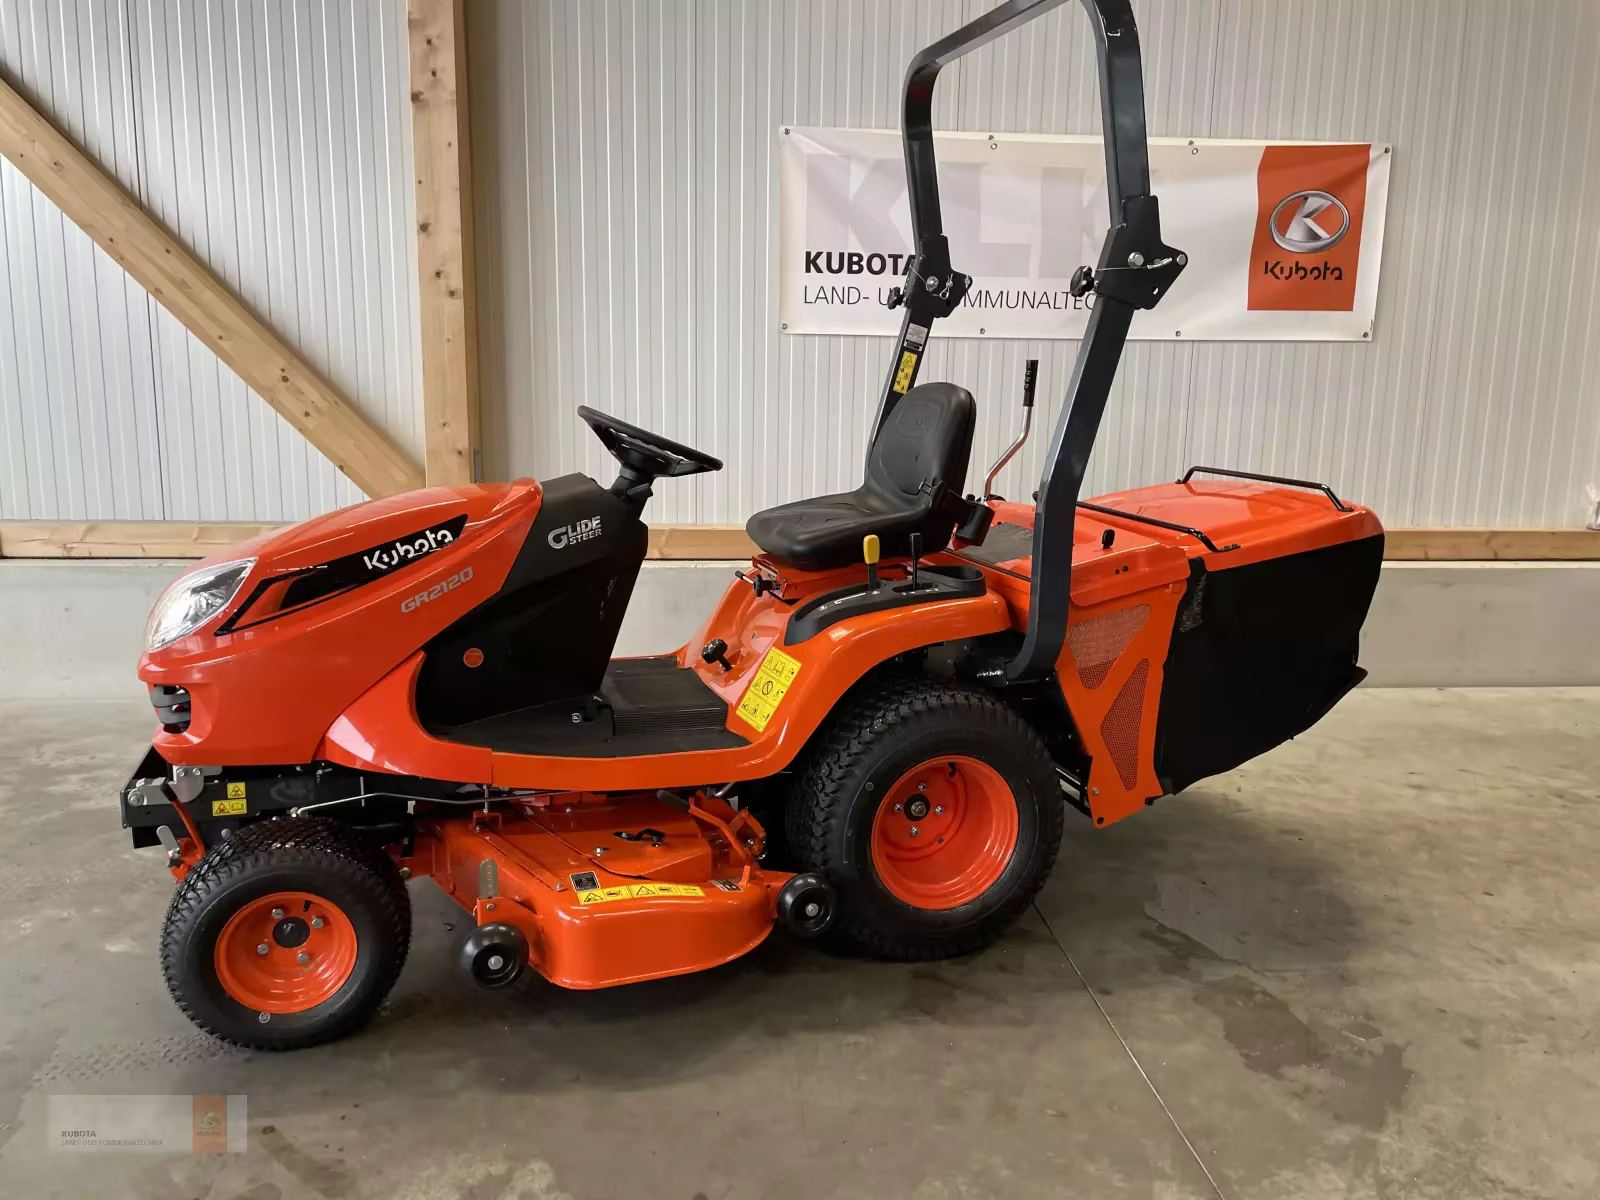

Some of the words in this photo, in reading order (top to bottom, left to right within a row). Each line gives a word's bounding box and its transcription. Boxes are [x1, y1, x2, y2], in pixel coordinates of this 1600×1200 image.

[1264, 261, 1343, 281] Kubota
[804, 285, 869, 305] LAND-
[547, 515, 602, 549] GLIDE
[569, 528, 603, 545] STEER
[363, 529, 454, 570] Kubota
[400, 566, 475, 613] GR2120
